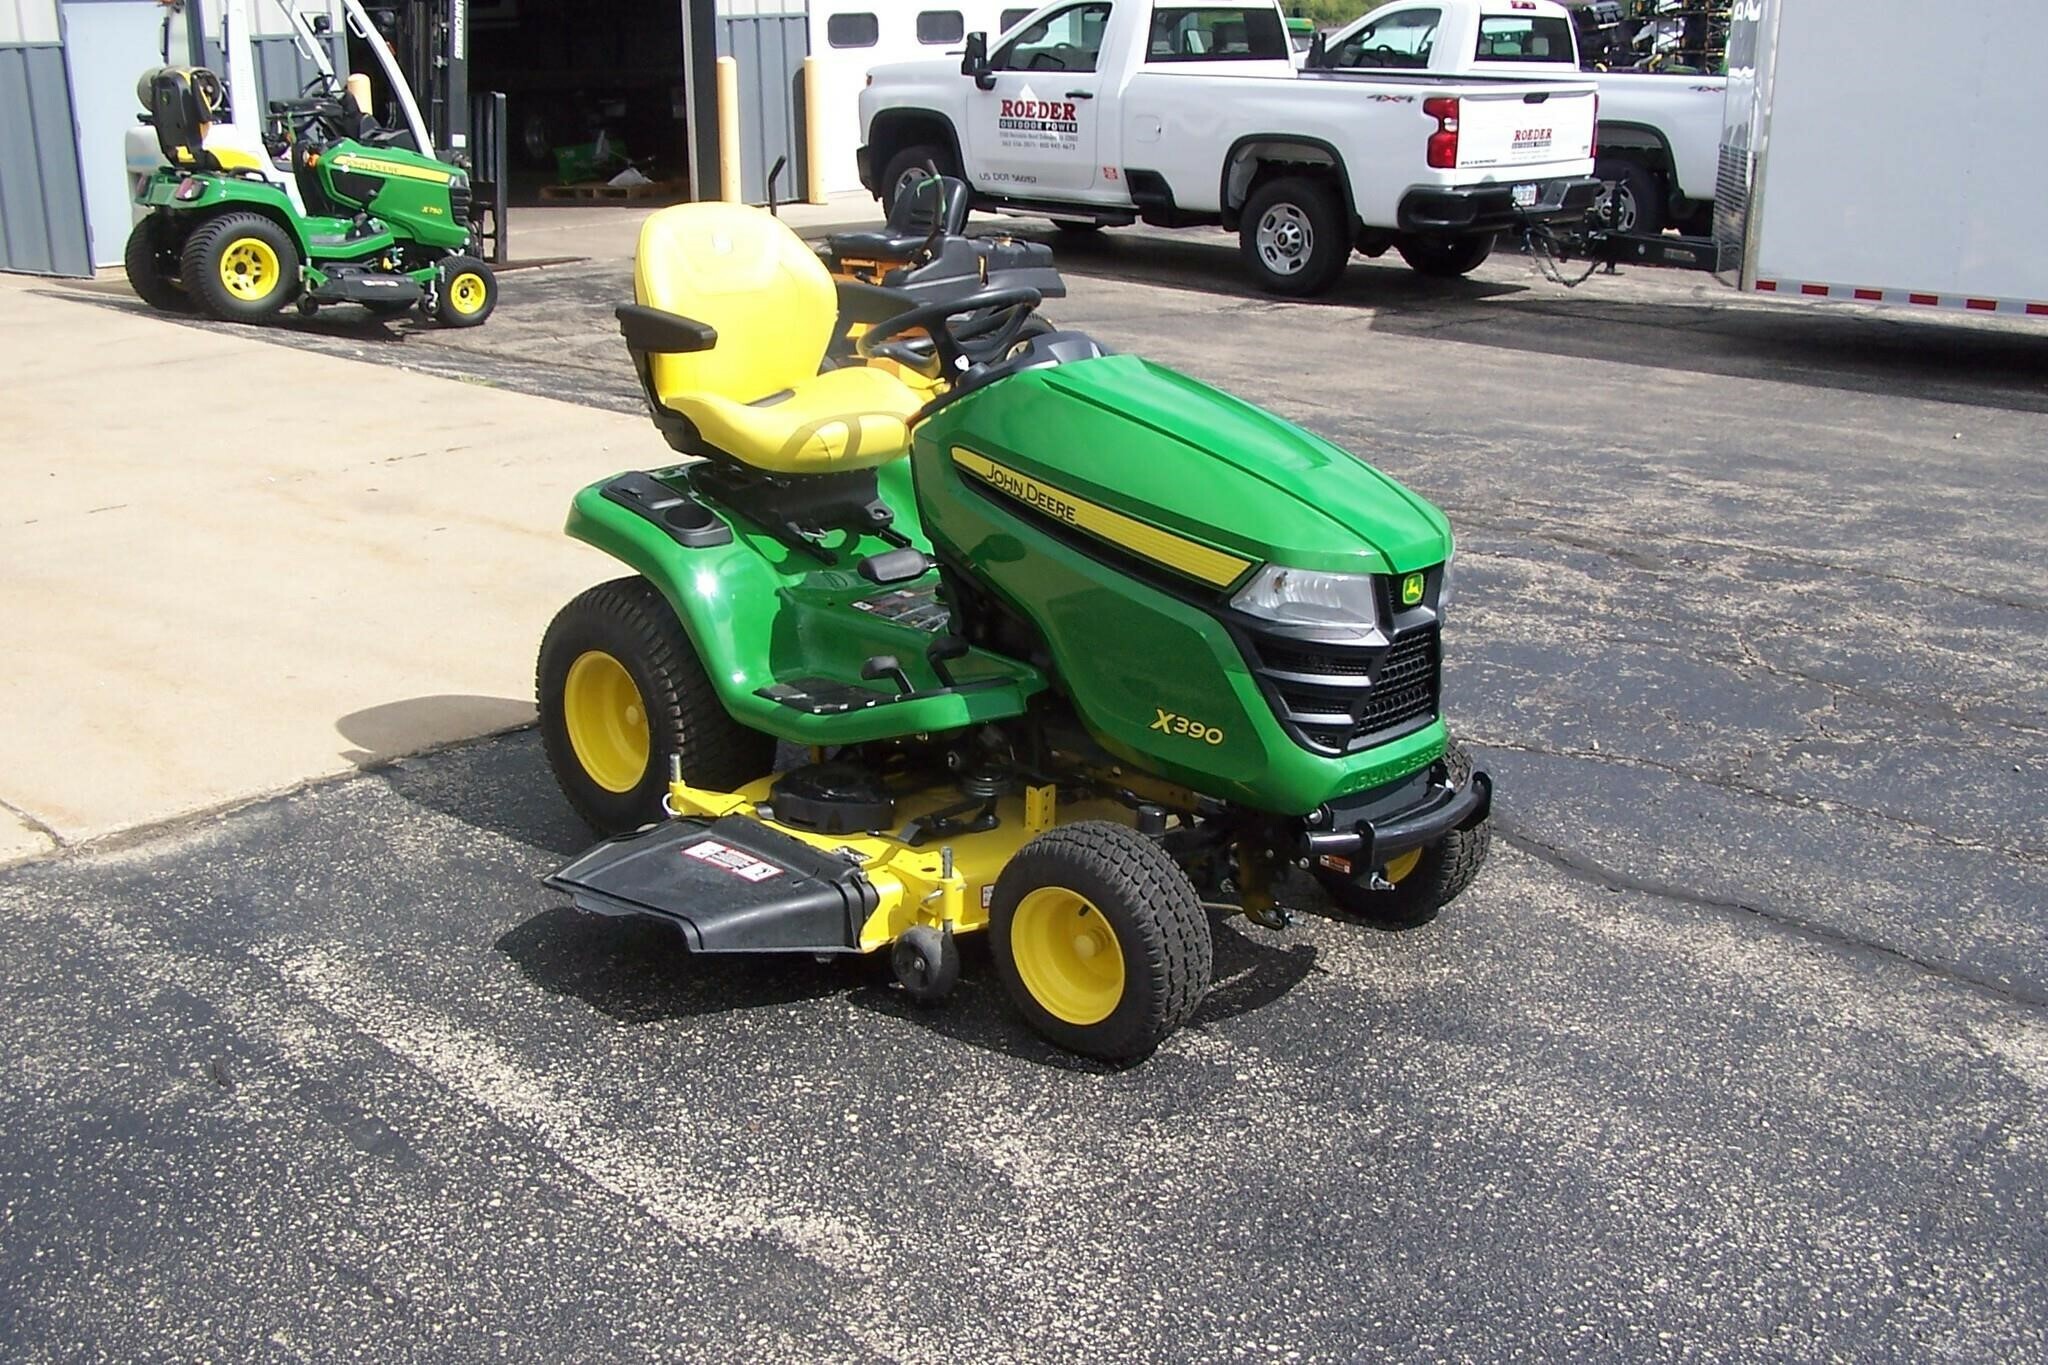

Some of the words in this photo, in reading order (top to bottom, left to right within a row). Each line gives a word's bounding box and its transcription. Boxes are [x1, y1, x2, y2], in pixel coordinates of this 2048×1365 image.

[1000, 100, 1076, 121] ROEDER
[1000, 120, 1042, 130] OUTDOOR
[1045, 122, 1077, 132] POWER
[1514, 128, 1552, 141] ROEDER
[986, 464, 1024, 497] JOHN
[1026, 482, 1077, 522] DEERE
[1149, 707, 1224, 746] X390
